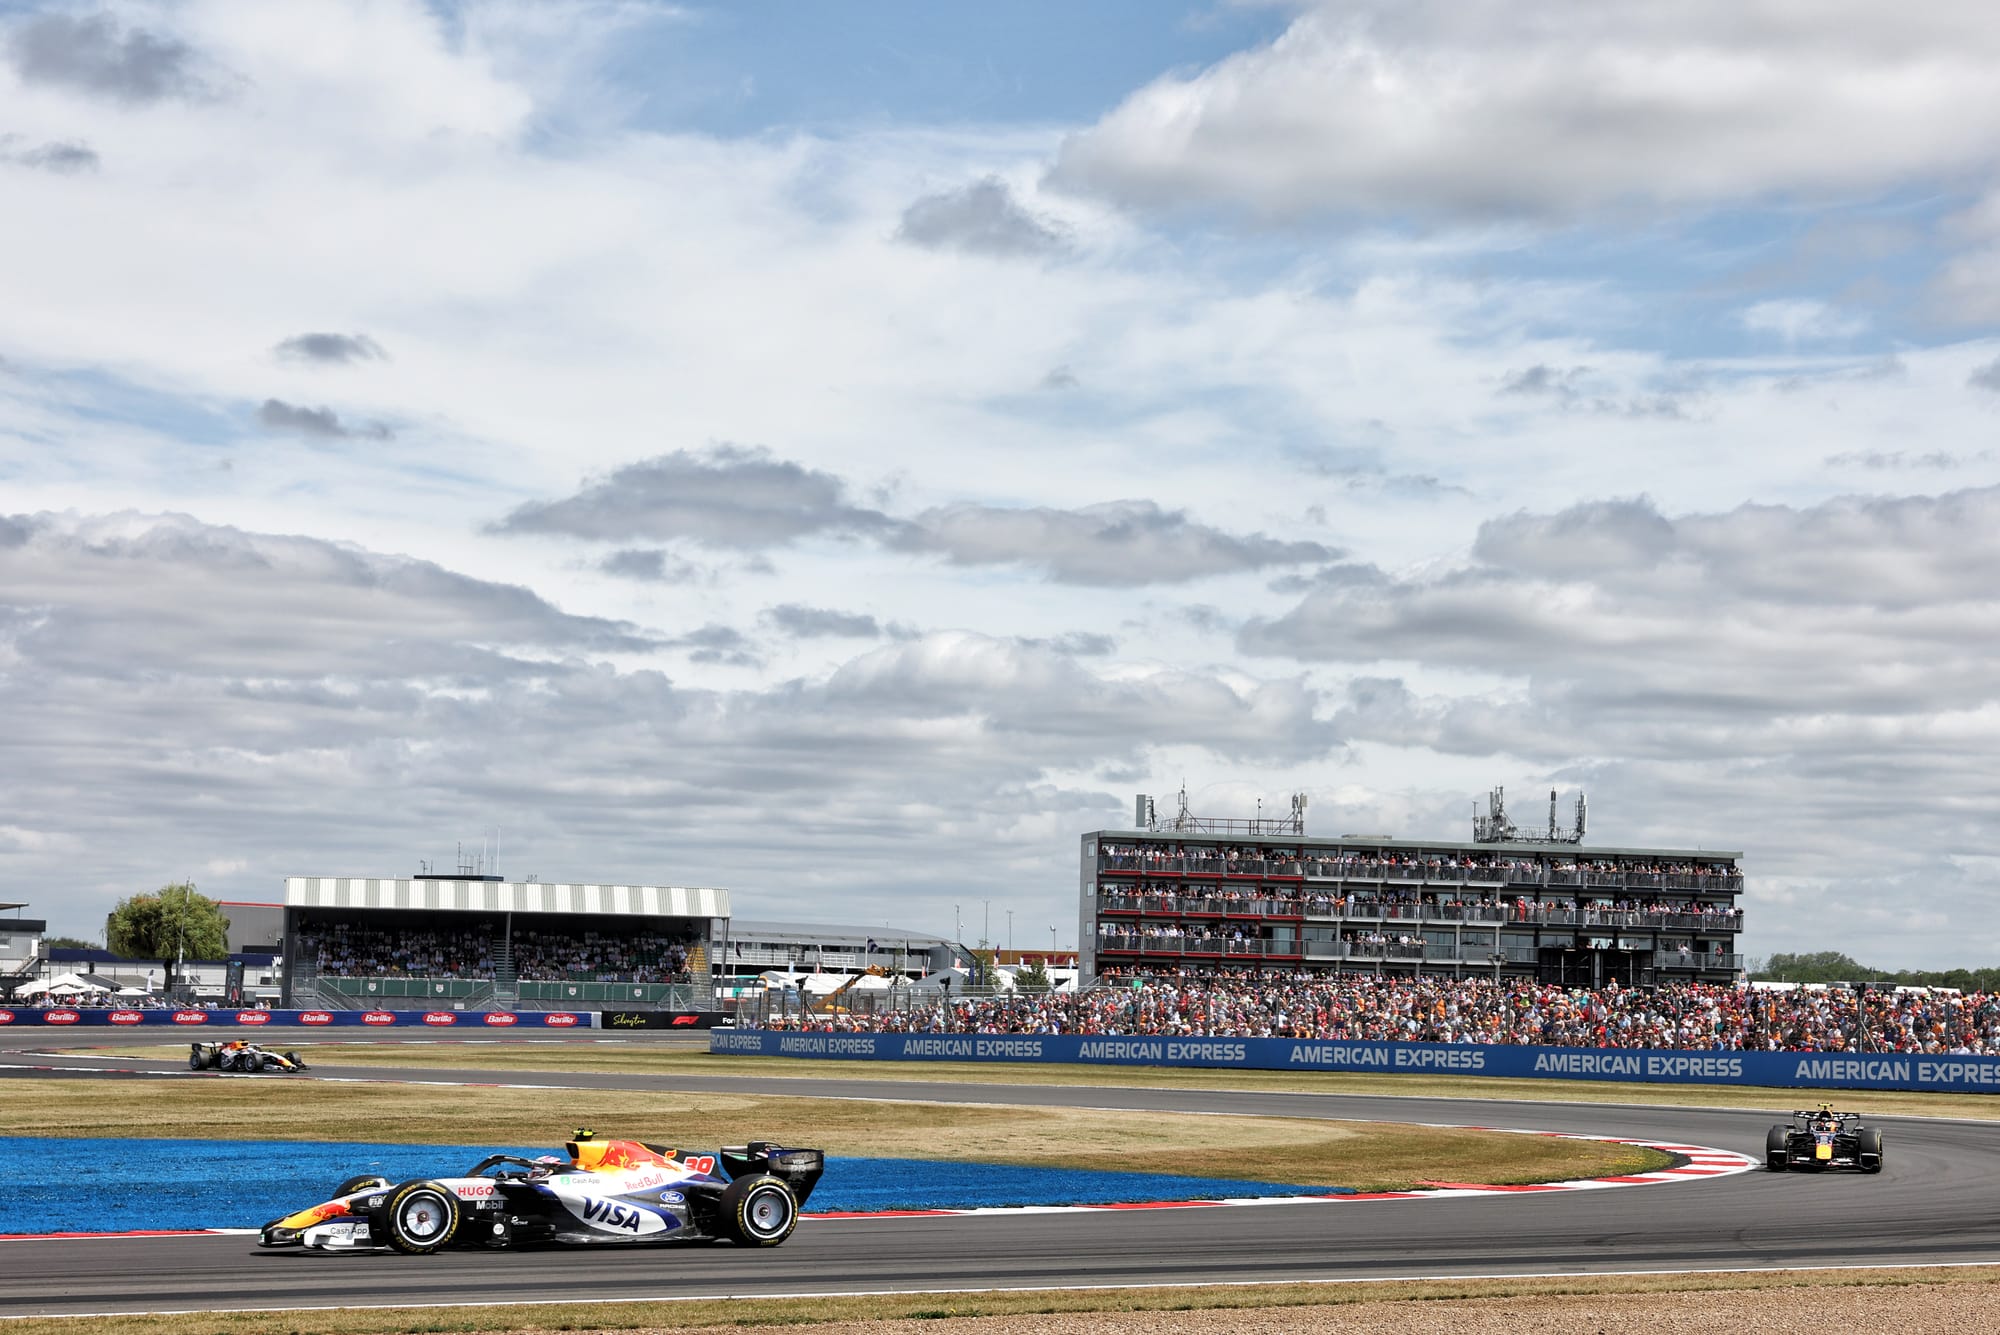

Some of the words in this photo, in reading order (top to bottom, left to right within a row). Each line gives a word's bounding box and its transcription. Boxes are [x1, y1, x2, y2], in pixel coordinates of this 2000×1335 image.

[48, 1013, 76, 1021] Barilla
[111, 1013, 139, 1021] Barilla
[240, 1014, 267, 1022] Barilla
[303, 1014, 329, 1022] Barilla
[365, 1014, 391, 1022] Barilla
[427, 1014, 453, 1022] Barilla
[488, 1015, 514, 1023] Barilla
[548, 1016, 575, 1024] Barilla
[729, 1035, 762, 1050] EXPRESS
[780, 1037, 825, 1053] AMERICAN
[828, 1038, 875, 1054] EXPRESS
[903, 1039, 972, 1055] AMERICAN
[976, 1040, 1042, 1057] EXPRESS
[1079, 1042, 1162, 1059] AMERICAN
[1167, 1043, 1246, 1061] EXPRESS
[1289, 1045, 1388, 1065] AMERICAN
[1395, 1048, 1485, 1069] EXPRESS
[1534, 1053, 1640, 1074] AMERICAN
[1647, 1056, 1743, 1077] EXPRESS
[1795, 1060, 1910, 1081] AMERICAN
[685, 1156, 715, 1175] 30
[625, 1181, 645, 1191] Red
[645, 1173, 664, 1186] Bull
[458, 1186, 495, 1196] HUGO
[476, 1200, 504, 1210] Mobil
[582, 1195, 641, 1233] VISA
[330, 1227, 350, 1235] Cash
[351, 1227, 368, 1236] App
